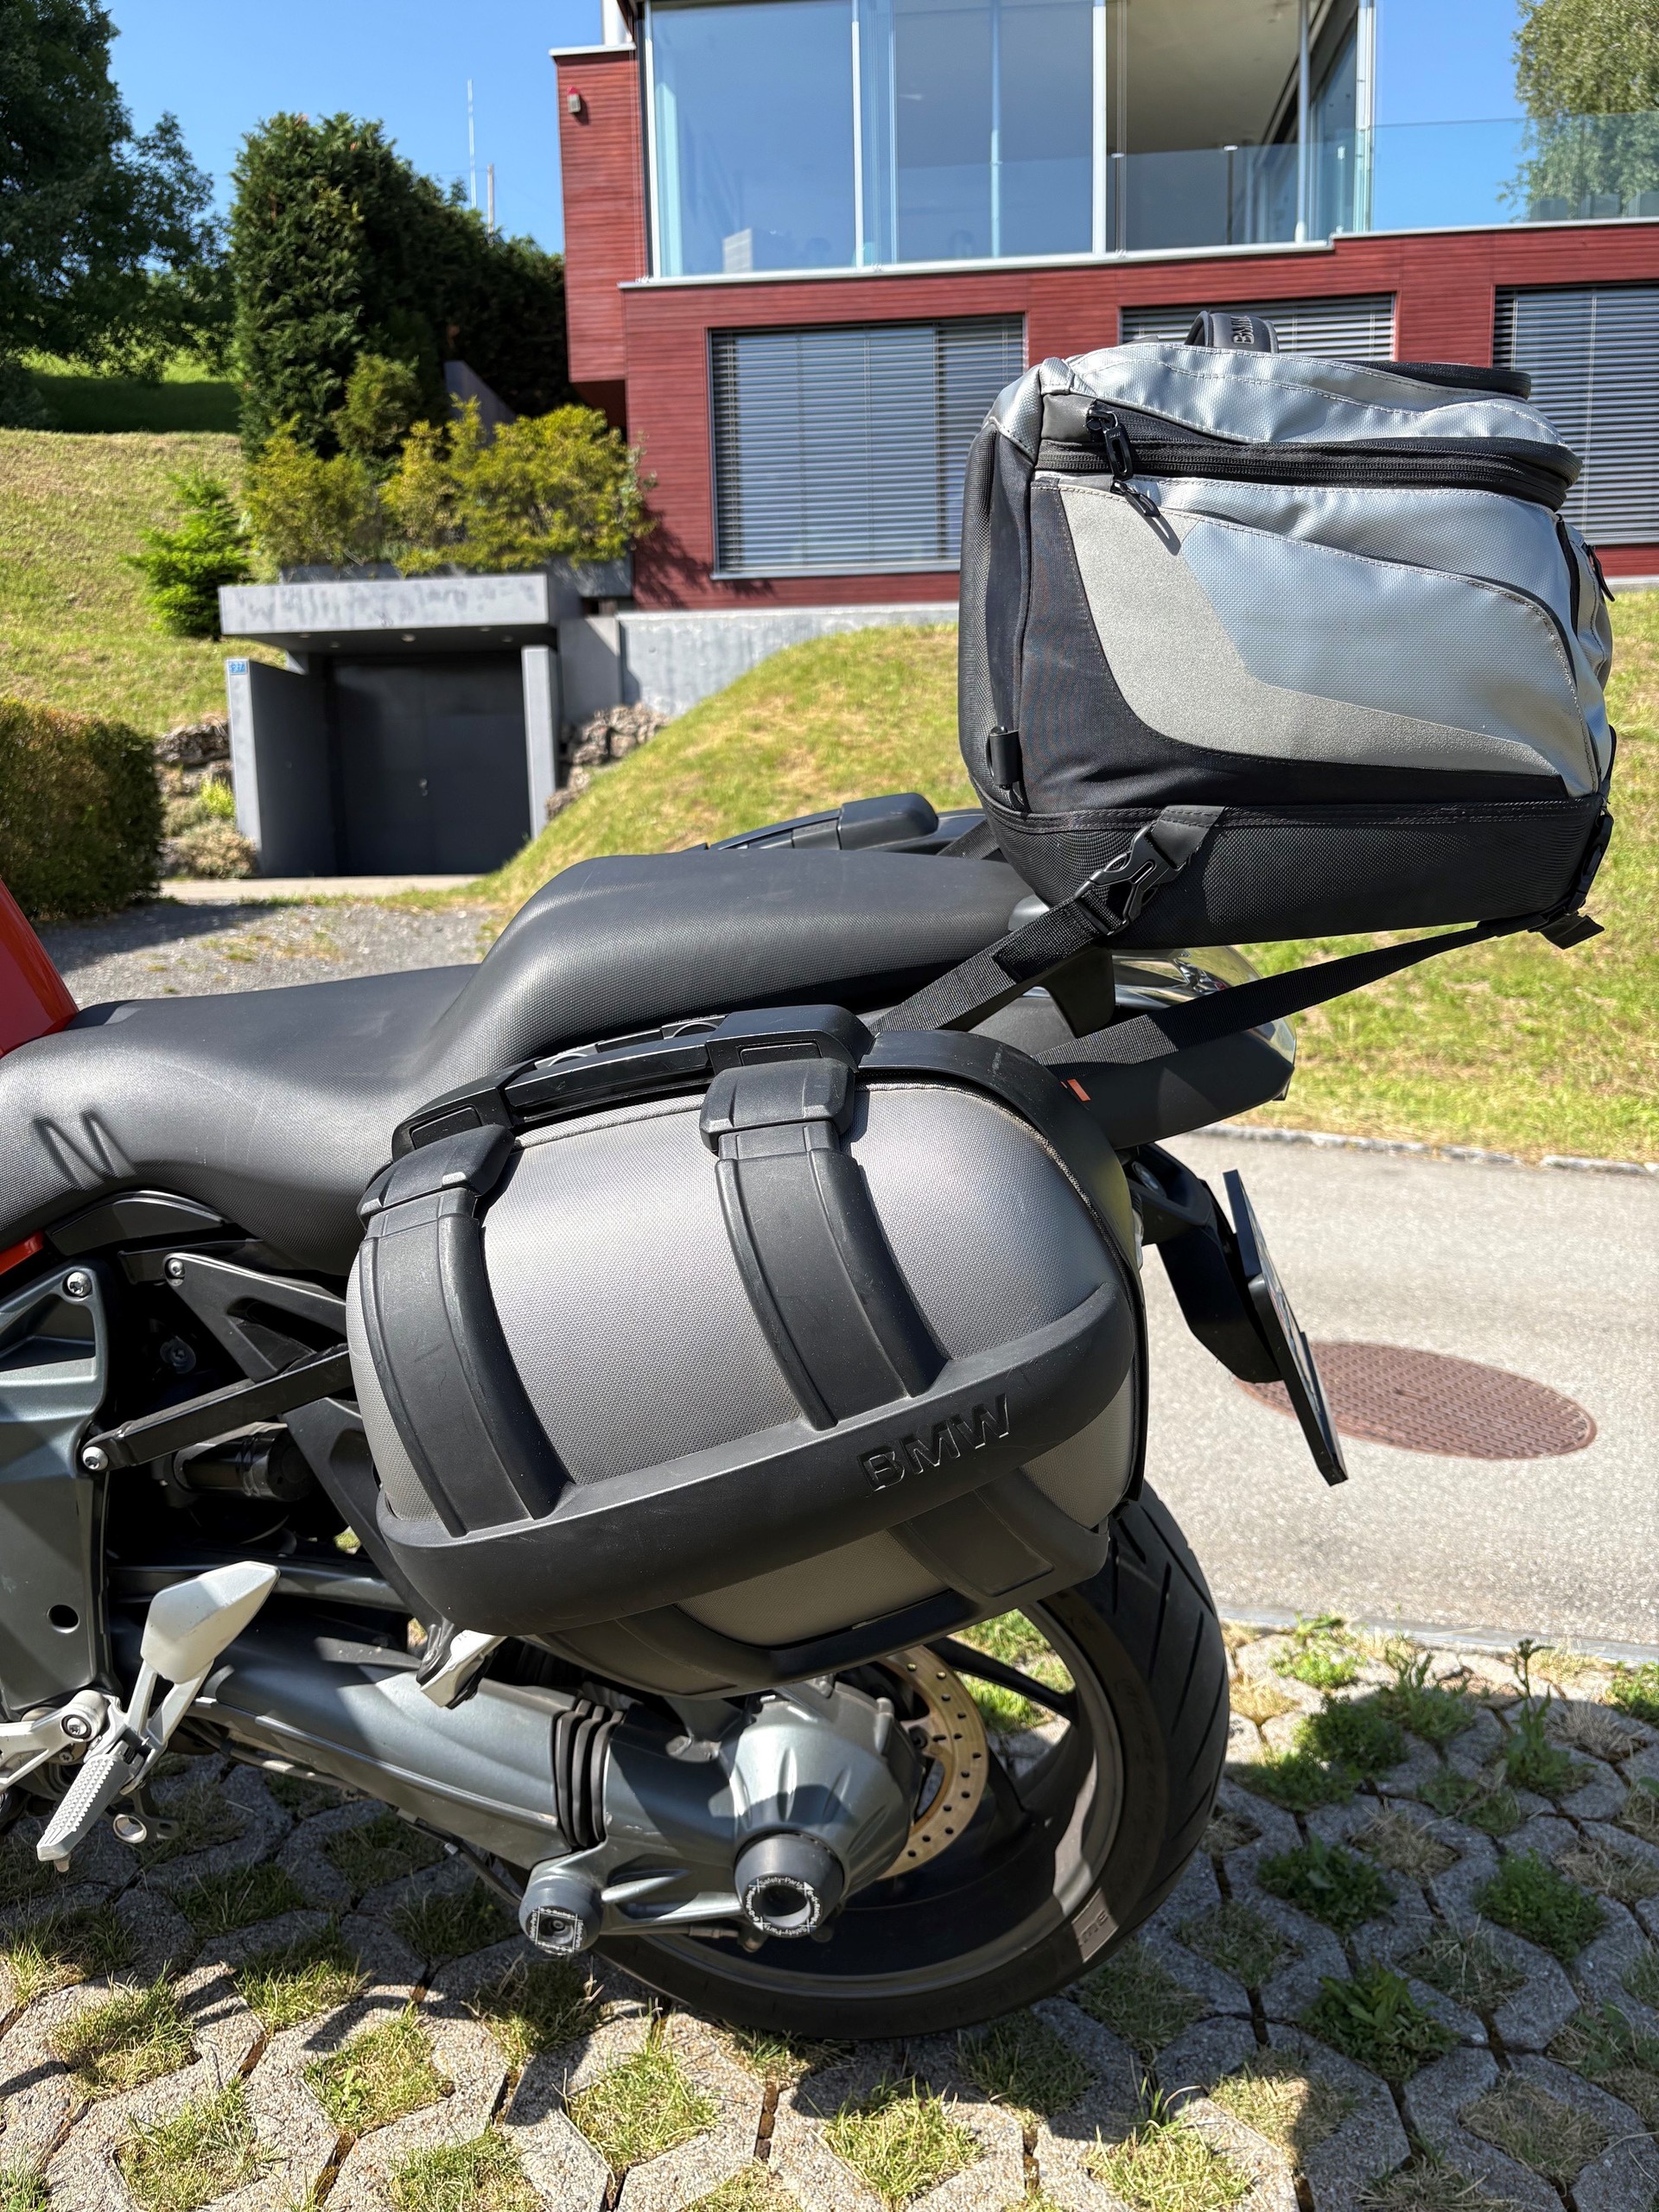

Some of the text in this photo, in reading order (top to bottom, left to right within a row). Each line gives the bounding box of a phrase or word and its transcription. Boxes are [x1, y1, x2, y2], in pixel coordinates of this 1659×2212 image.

[1230, 315, 1255, 344] BMW
[856, 1392, 1010, 1495] BMW
[760, 1877, 804, 1889] Safety-Parts
